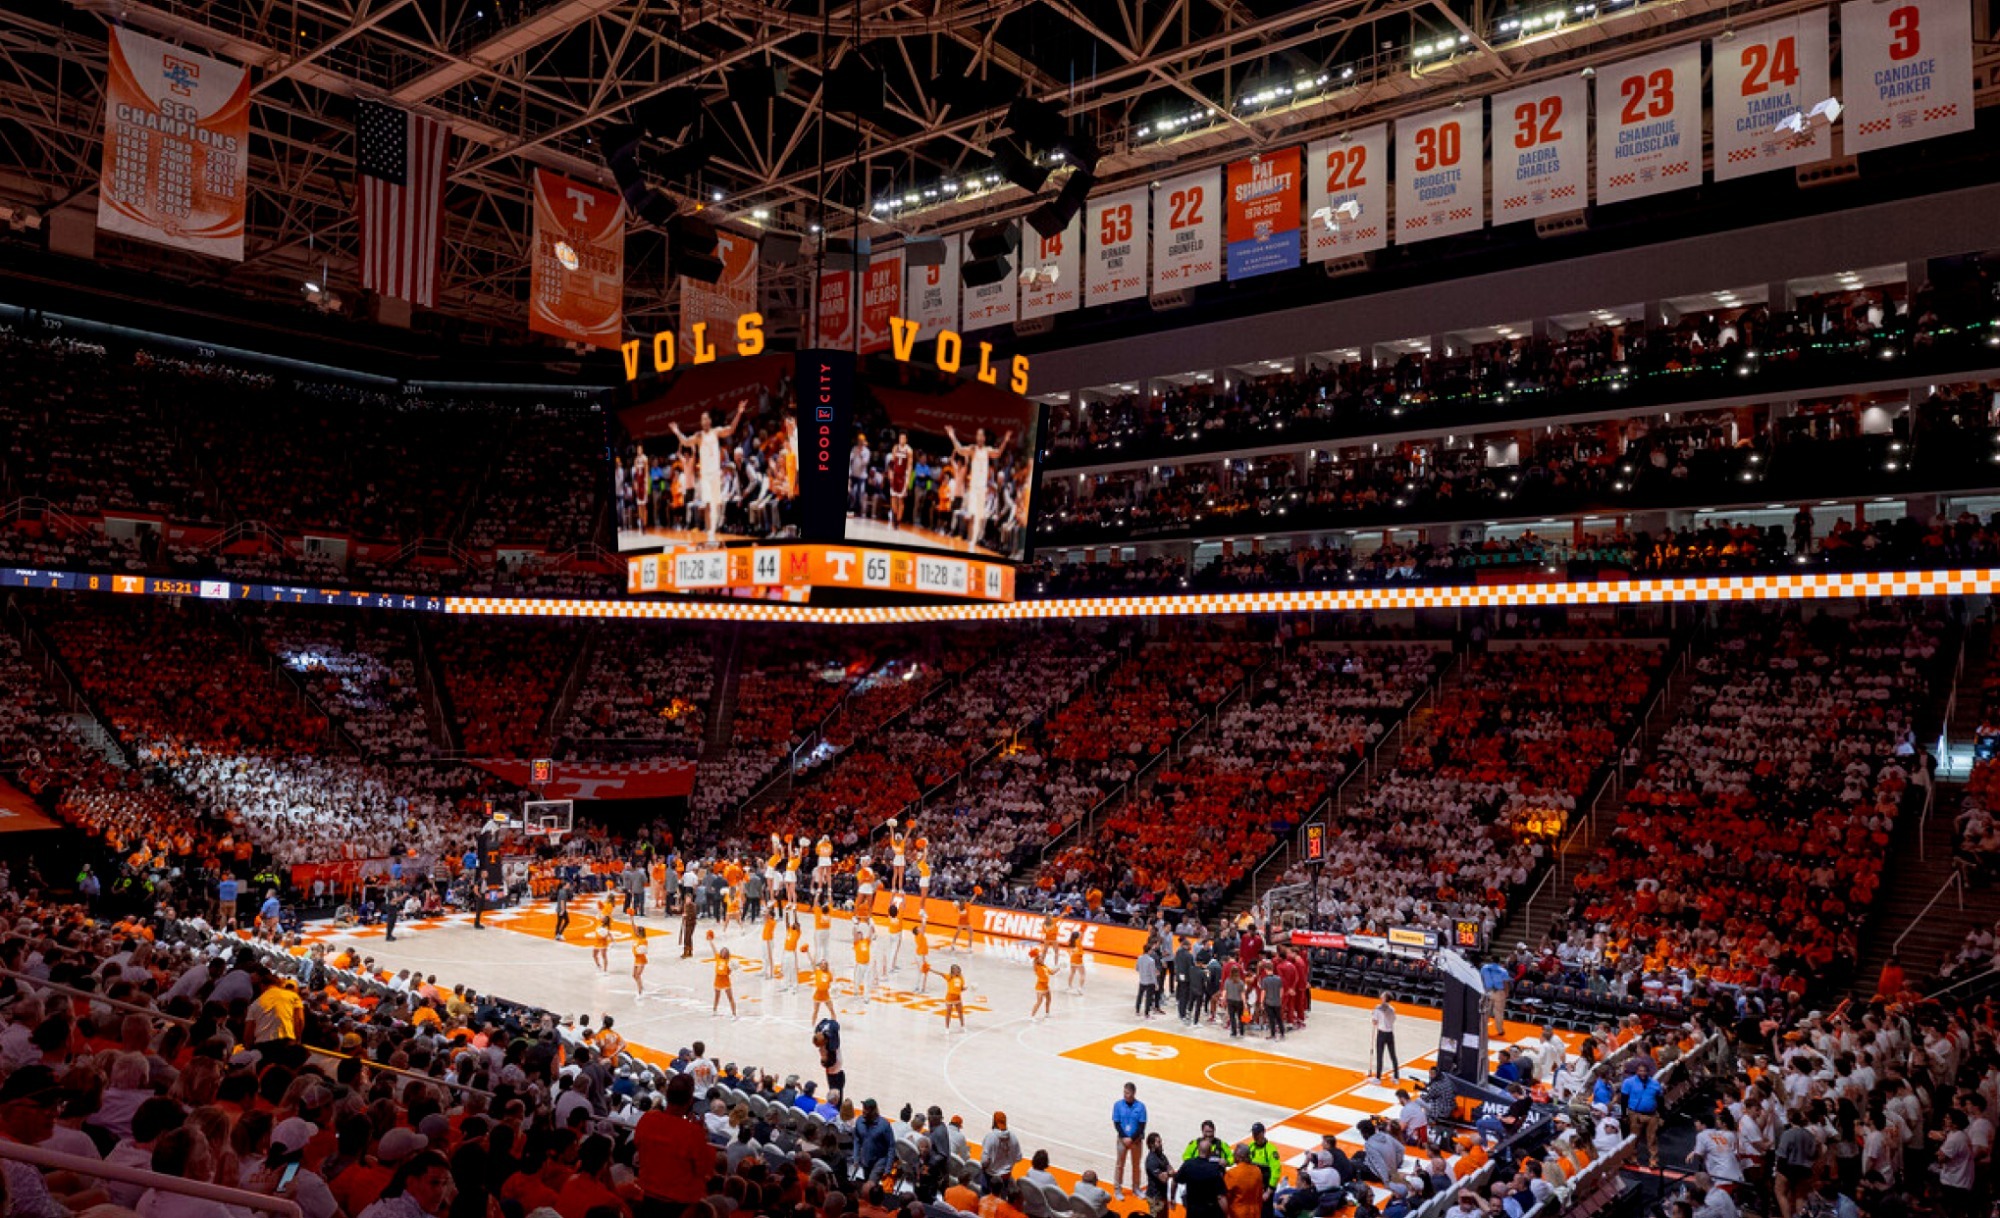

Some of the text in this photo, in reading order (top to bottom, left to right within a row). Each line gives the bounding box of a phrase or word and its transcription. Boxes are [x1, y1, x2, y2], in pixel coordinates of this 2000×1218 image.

[1889, 6, 1920, 60] 3
[1742, 36, 1799, 96] 24
[1874, 58, 1935, 86] CANDACE
[1621, 68, 1673, 125] 23
[1880, 76, 1931, 100] PARKER
[160, 98, 197, 124] SEC
[1748, 92, 1791, 115] TAMIKA
[116, 103, 238, 153] CHAMPIONS
[1515, 96, 1562, 148] 32
[1619, 119, 1675, 144] CHAMIQUE
[1415, 122, 1460, 171] 30
[1519, 147, 1557, 166] DAEDRA
[1615, 132, 1680, 158] HOLDSCLAW
[1253, 160, 1275, 181] PAT
[1327, 145, 1365, 193] 22
[1413, 169, 1461, 190] BRIDGETTE
[1516, 160, 1560, 180] CHARLES
[1235, 172, 1292, 202] SUMMITT
[1419, 182, 1456, 200] GORDON
[566, 187, 594, 222] T
[1170, 186, 1203, 230] 22
[1101, 204, 1132, 246] 53
[1041, 232, 1062, 260] 14
[1168, 240, 1204, 257] GRUNFELD
[1176, 230, 1196, 244] ERNIE
[1100, 245, 1131, 261] BERNARD
[1107, 257, 1123, 269] KING
[822, 280, 844, 298] JOHN
[872, 269, 890, 288] RAY
[865, 284, 898, 306] MEARS
[621, 312, 765, 381] VOLS
[889, 316, 1028, 395] VOLS
[820, 364, 831, 403] CITY
[819, 425, 830, 471] FOOD
[643, 561, 655, 584] 65
[679, 559, 704, 580] 11:28
[758, 555, 775, 578] 44
[790, 552, 809, 573] M
[826, 551, 856, 581] T
[867, 558, 886, 580] 65
[920, 563, 948, 584] 11:28
[89, 576, 99, 589] 8
[120, 577, 137, 592] T
[153, 581, 192, 594] 15:21
[241, 585, 250, 598] 7
[988, 572, 998, 590] 44
[487, 850, 499, 865] T
[983, 910, 1098, 947] TENNESE
[1460, 932, 1474, 944] 30
